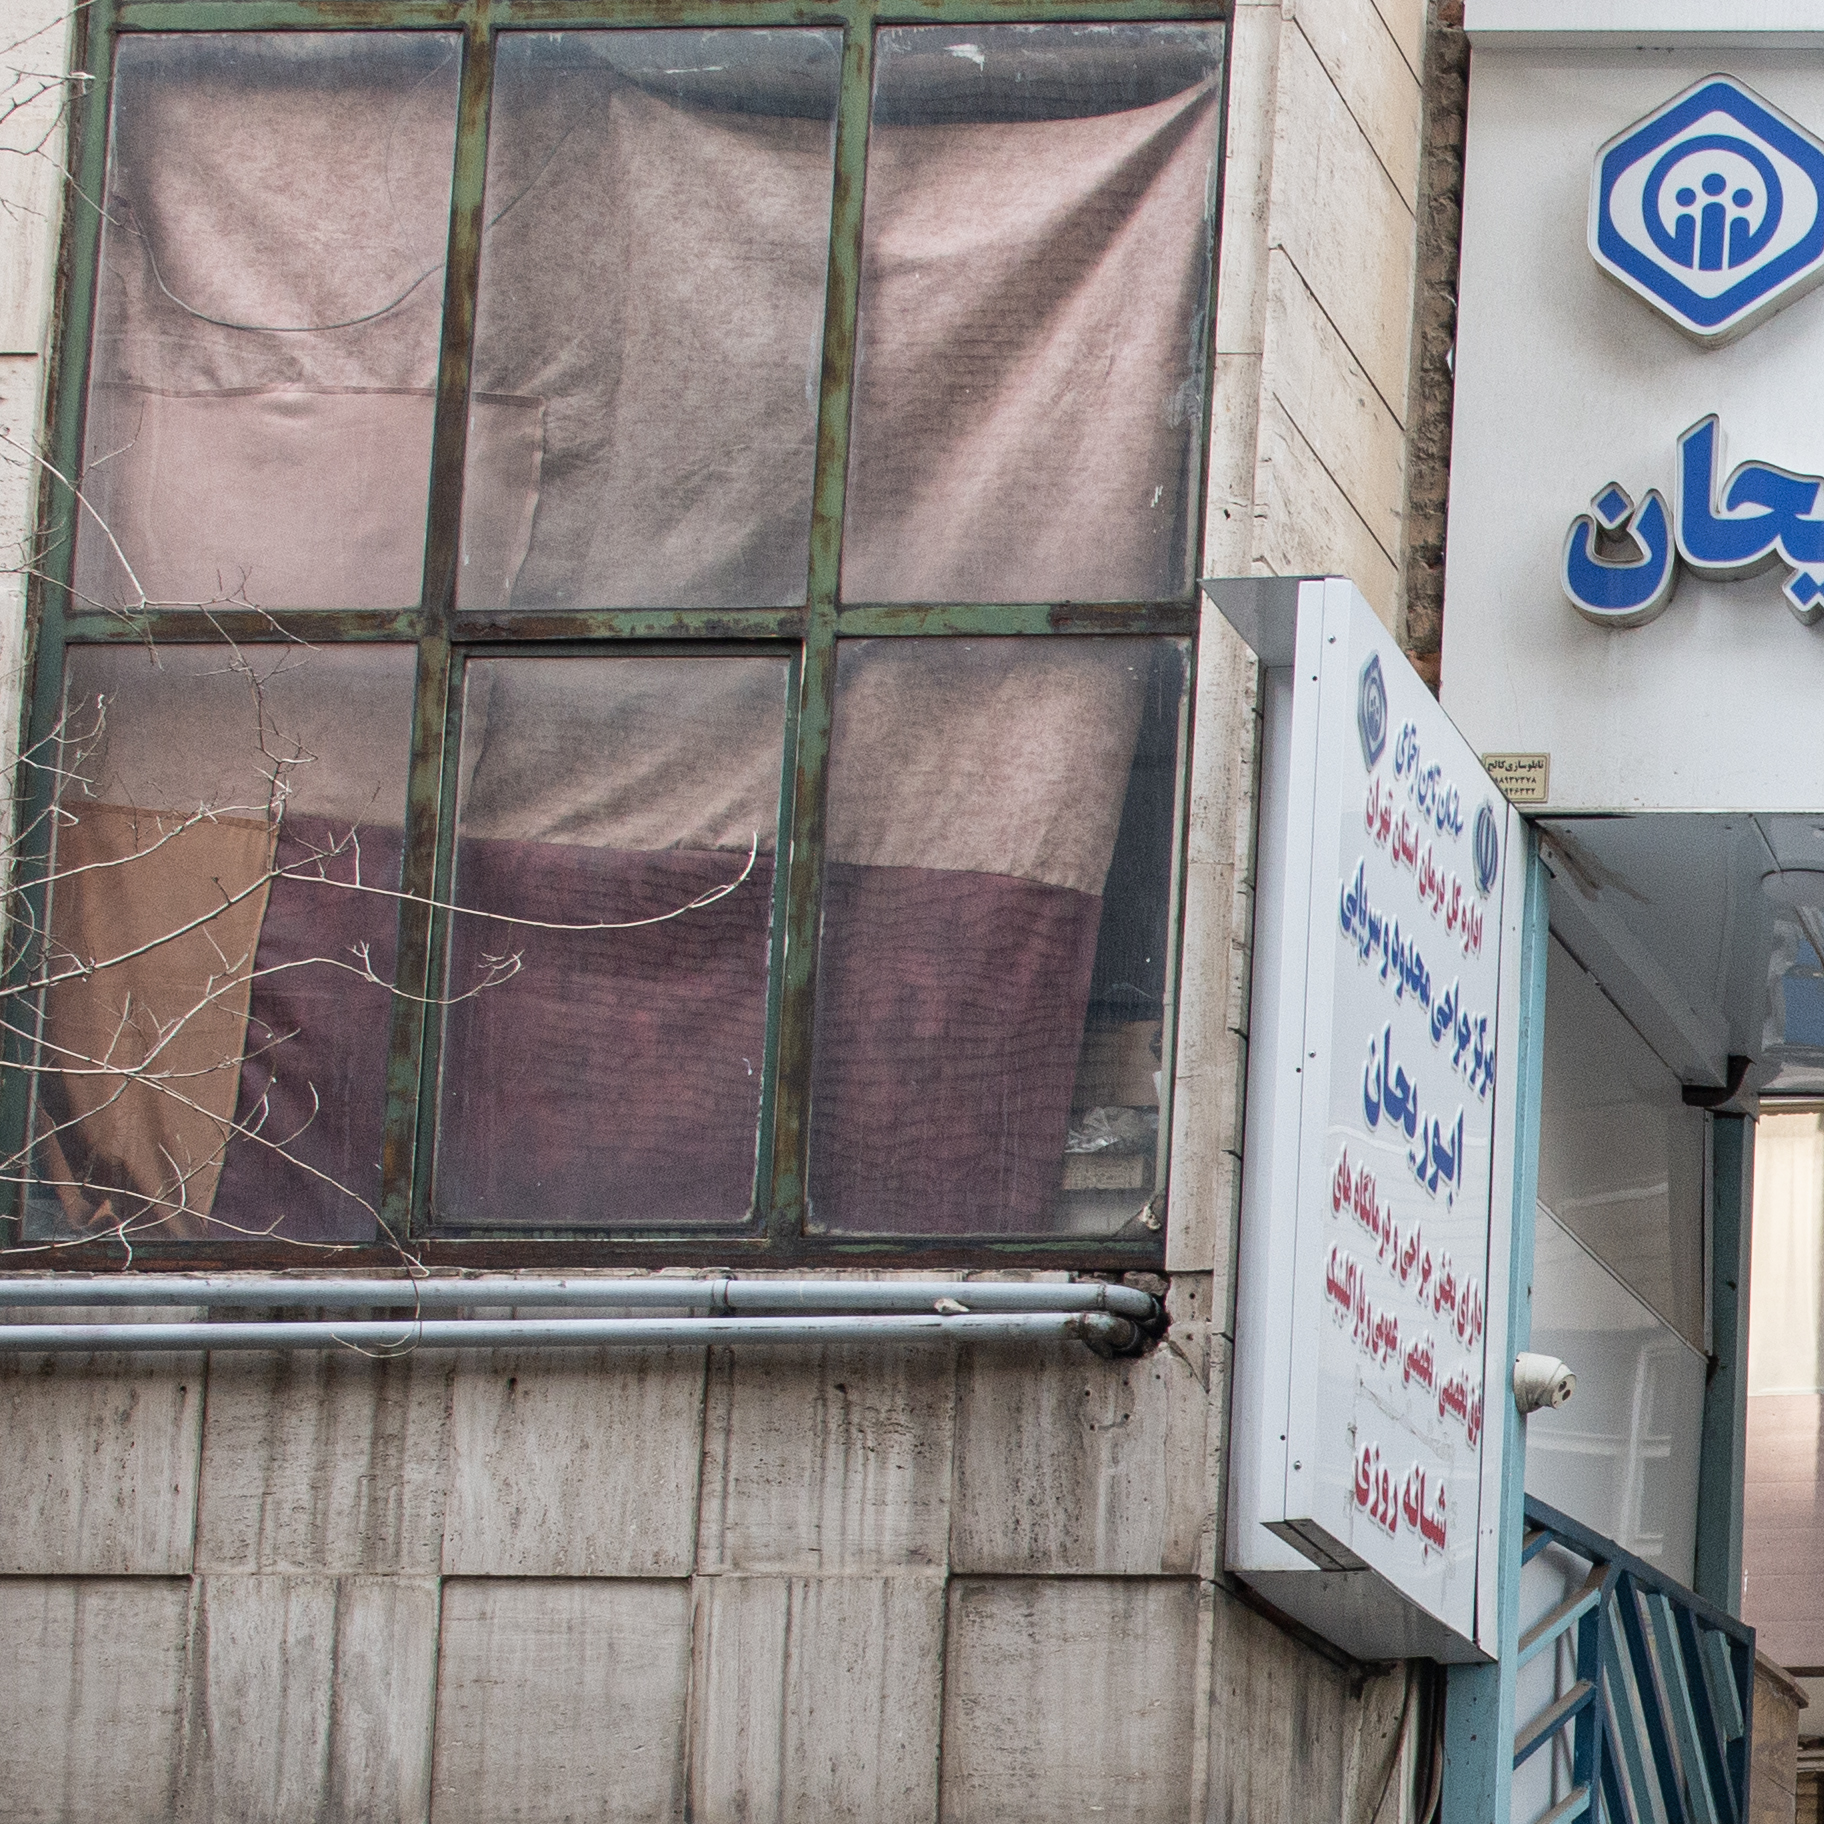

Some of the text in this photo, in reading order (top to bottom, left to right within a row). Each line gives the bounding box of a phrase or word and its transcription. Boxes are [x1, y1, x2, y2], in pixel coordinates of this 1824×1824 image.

[1394, 721, 1421, 795] اجتماعی
[1436, 784, 1464, 837] سازمان
[1365, 775, 1484, 953] اداره کل درمان استان تهران
[1339, 858, 1495, 1098] مرکز جراحی محدود و سرپایی
[1363, 1023, 1465, 1208] ابوریحان
[1399, 1223, 1433, 1305] جراحی
[1433, 1250, 1458, 1330] بخش
[1371, 1312, 1398, 1365] عمومی
[1456, 1276, 1483, 1347] دارای
[1467, 1379, 1482, 1446] فوق
[1354, 1445, 1448, 1556] شبانه روزی
